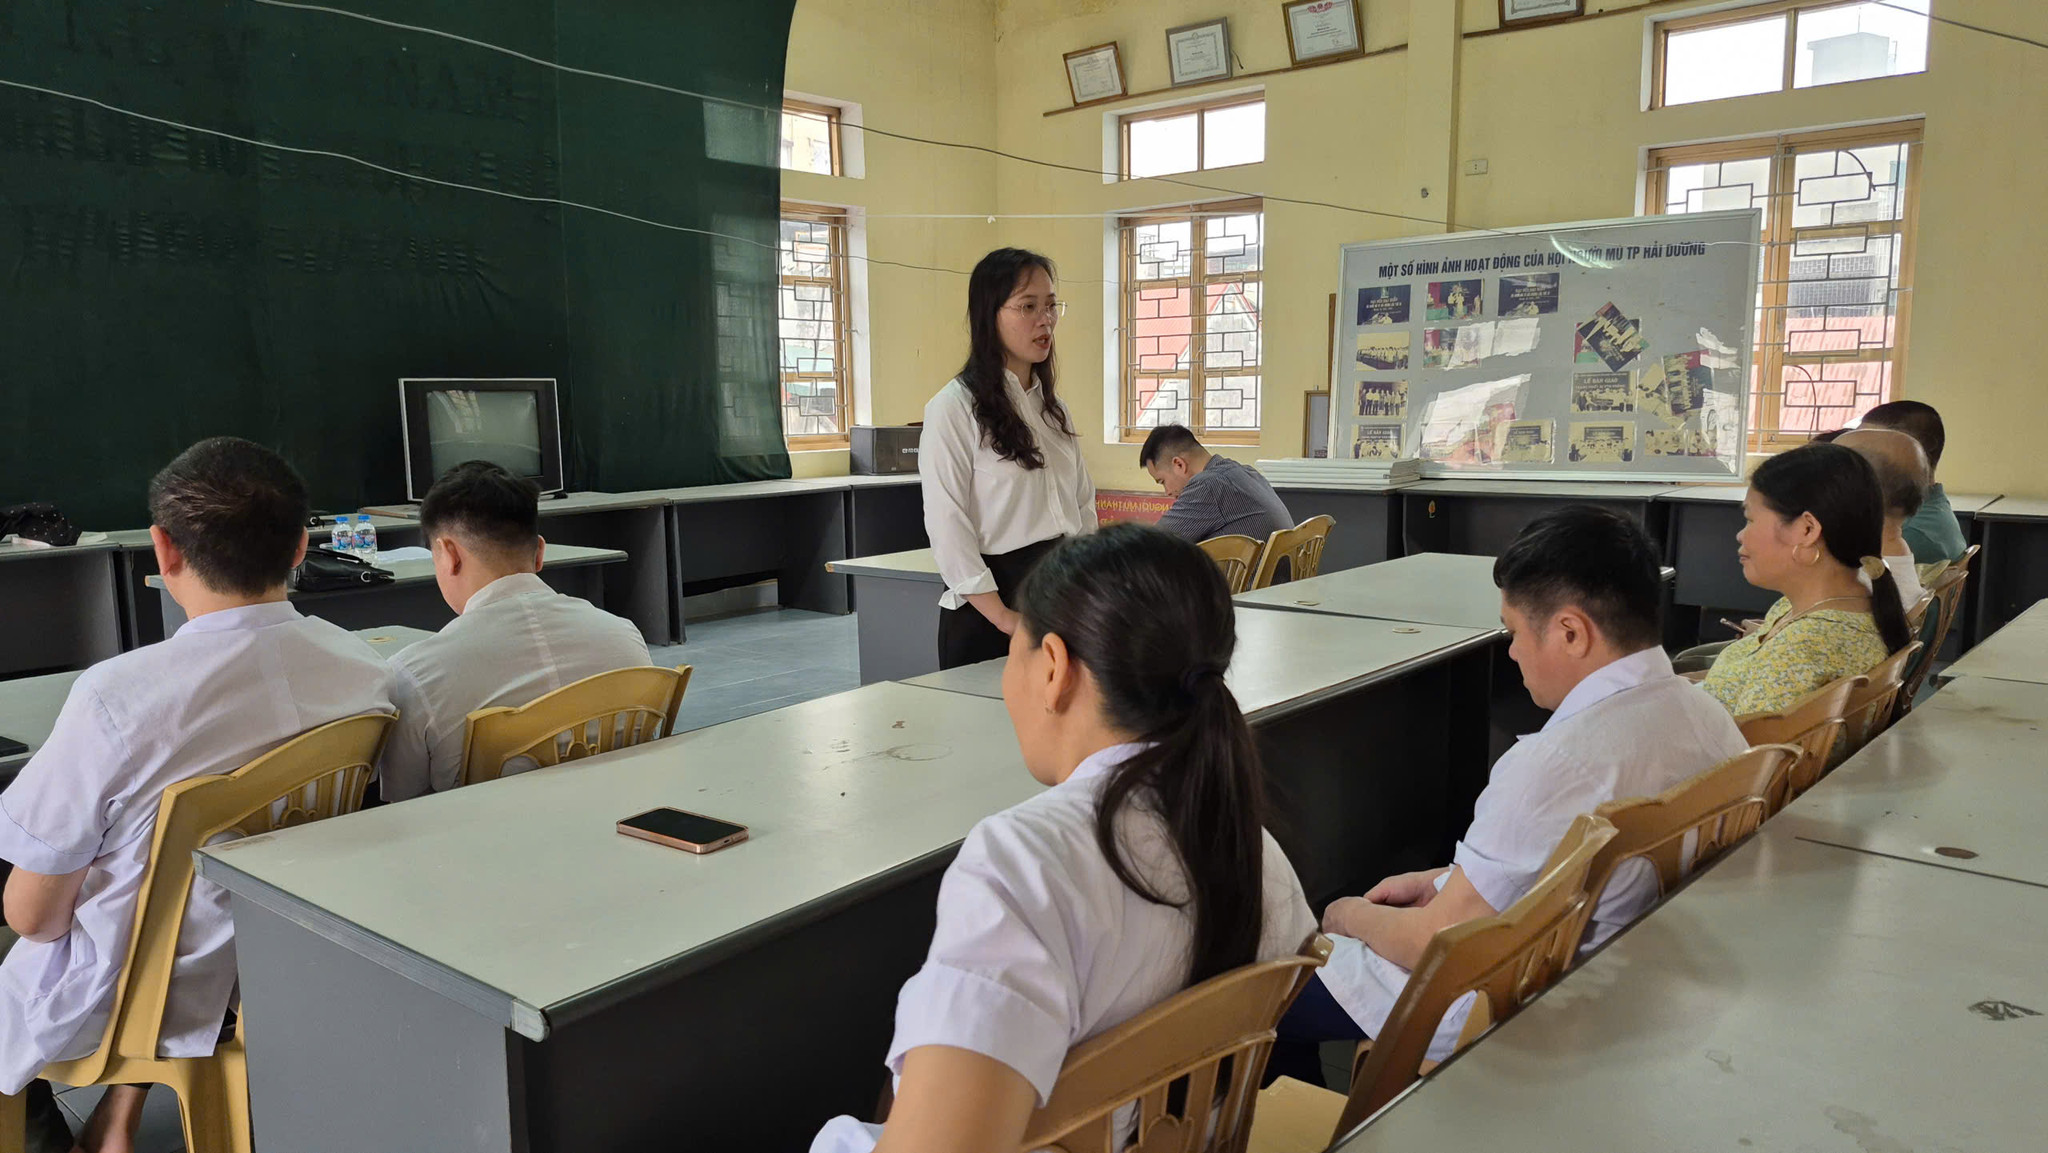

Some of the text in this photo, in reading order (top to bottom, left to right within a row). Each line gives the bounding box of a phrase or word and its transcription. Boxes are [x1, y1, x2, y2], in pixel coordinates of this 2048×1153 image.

[1379, 262, 1399, 280] MỘT
[1401, 259, 1415, 277] SỐ
[1416, 260, 1439, 275] HÌNH
[1441, 257, 1462, 274] ẢNH
[1464, 257, 1491, 273] HOẠT
[1493, 253, 1521, 273] ĐỘNG
[1523, 249, 1544, 267] CỦA
[1547, 251, 1565, 268] HỘI
[1626, 246, 1641, 260] TP
[1643, 241, 1662, 259] HẢI
